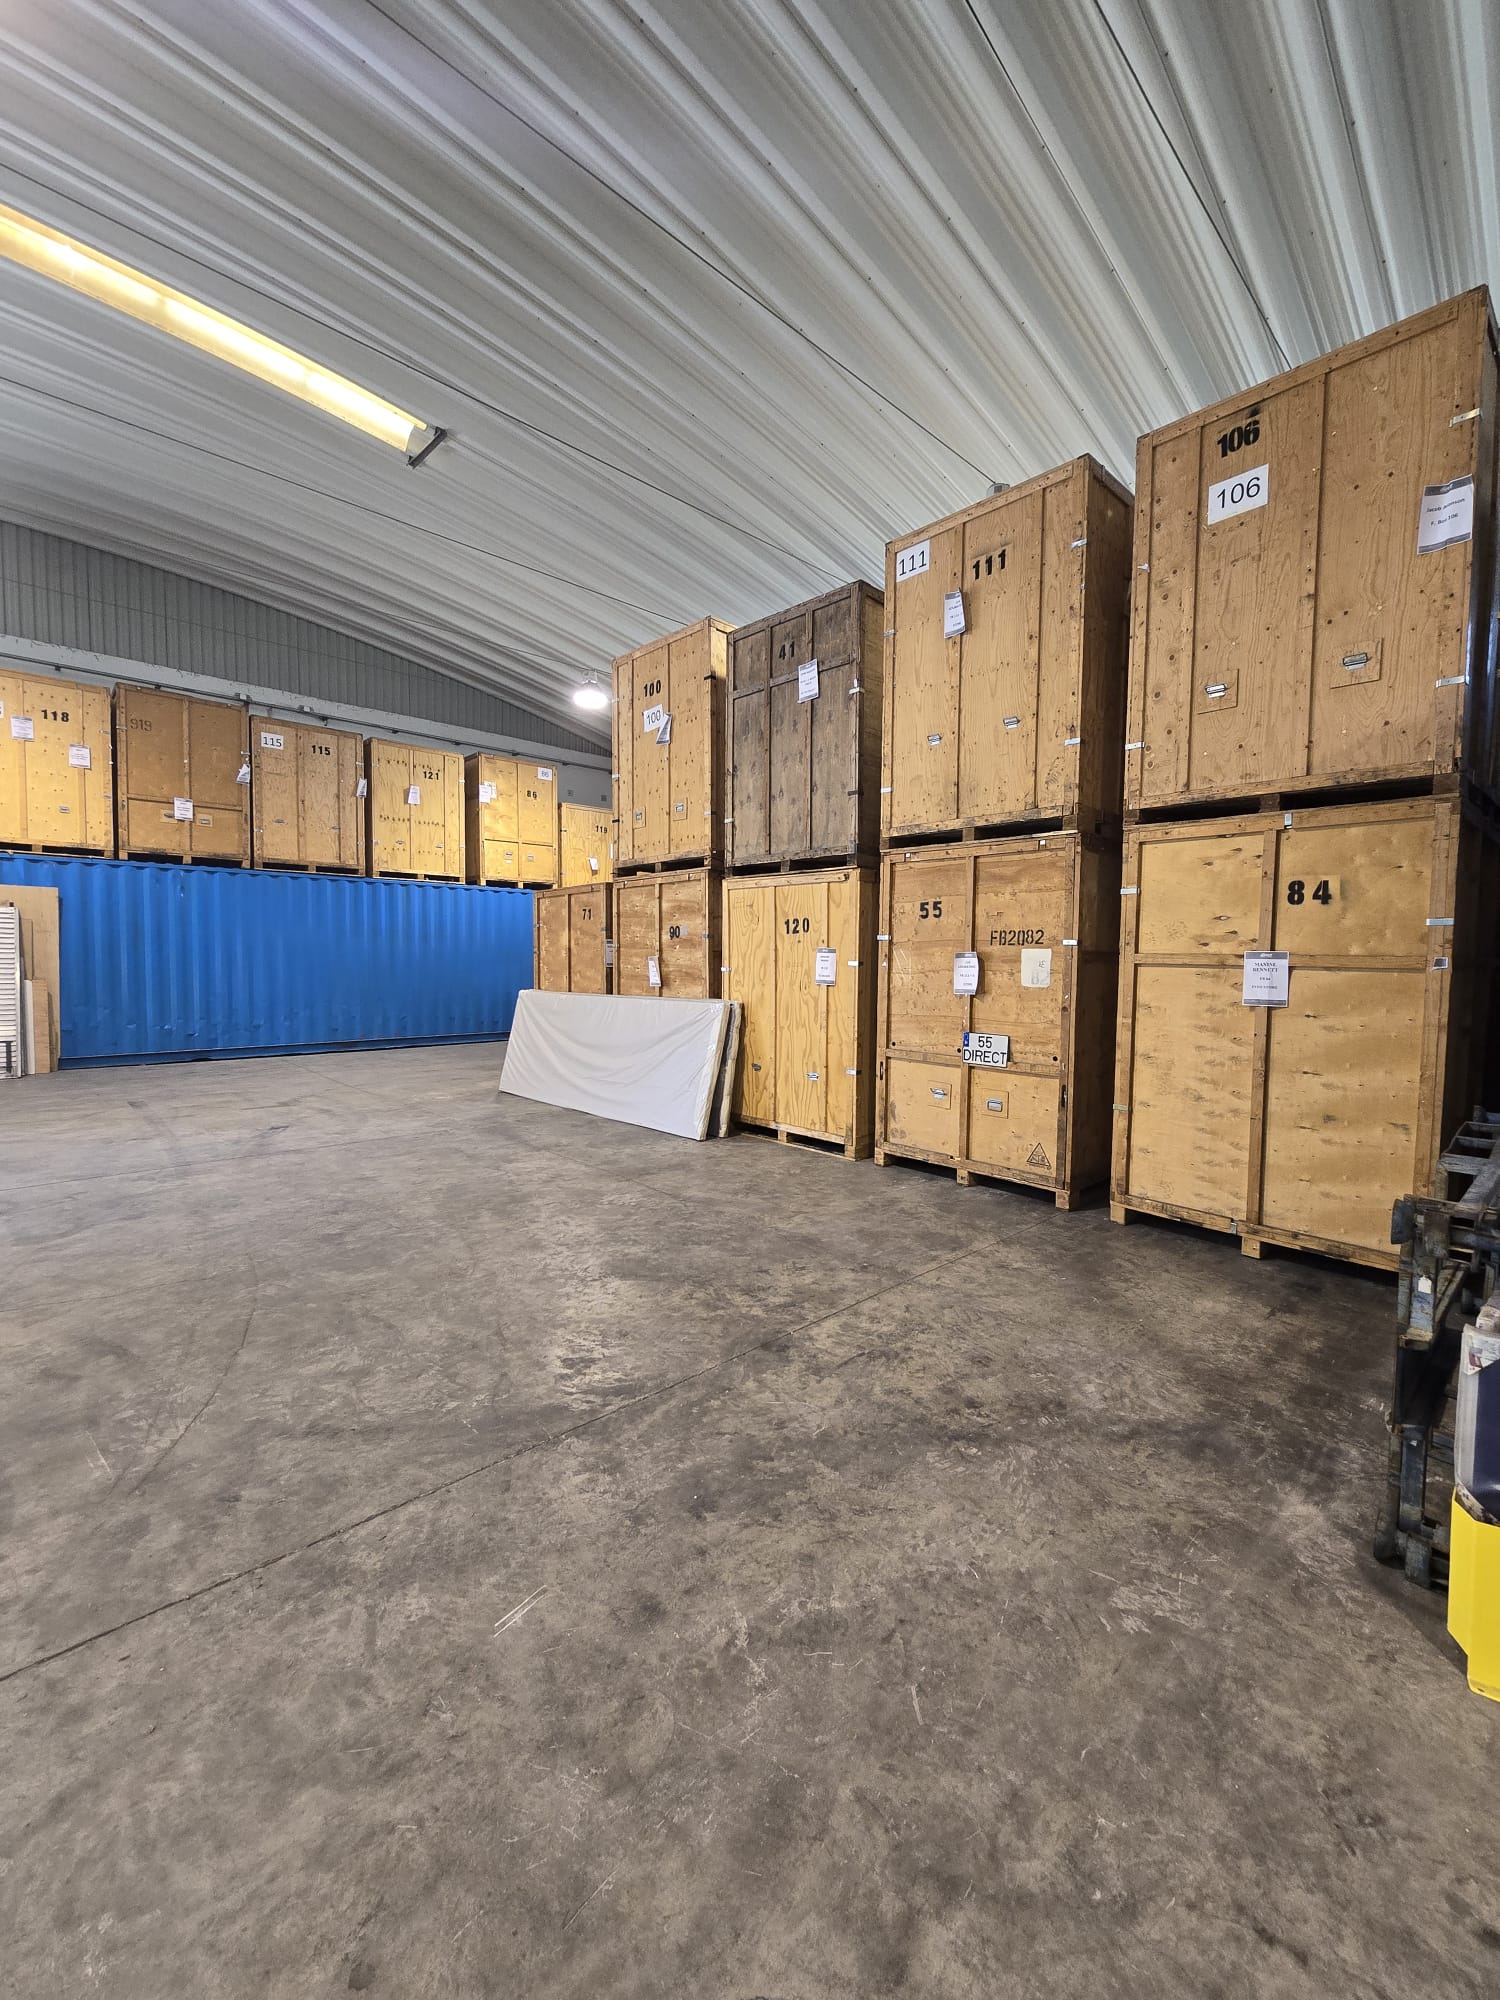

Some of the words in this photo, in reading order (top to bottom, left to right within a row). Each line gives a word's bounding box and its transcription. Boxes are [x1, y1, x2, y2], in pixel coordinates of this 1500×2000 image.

[1217, 420, 1260, 458] 106
[1217, 476, 1261, 509] 106
[898, 550, 927, 576] 111
[972, 549, 1007, 581] 111
[778, 640, 795, 660] 41
[643, 679, 662, 697] 100
[40, 709, 70, 723] 118
[647, 710, 661, 725] 100
[263, 736, 282, 748] 115
[311, 744, 331, 756] 115
[423, 770, 439, 781] 121
[1287, 879, 1333, 906] 84
[582, 908, 593, 921] 71
[919, 901, 943, 920] 55
[669, 925, 681, 940] 90
[784, 917, 810, 935] 120
[989, 929, 1045, 947] FB2082
[978, 1036, 993, 1049] 55
[963, 1049, 1008, 1065] DIRECT
